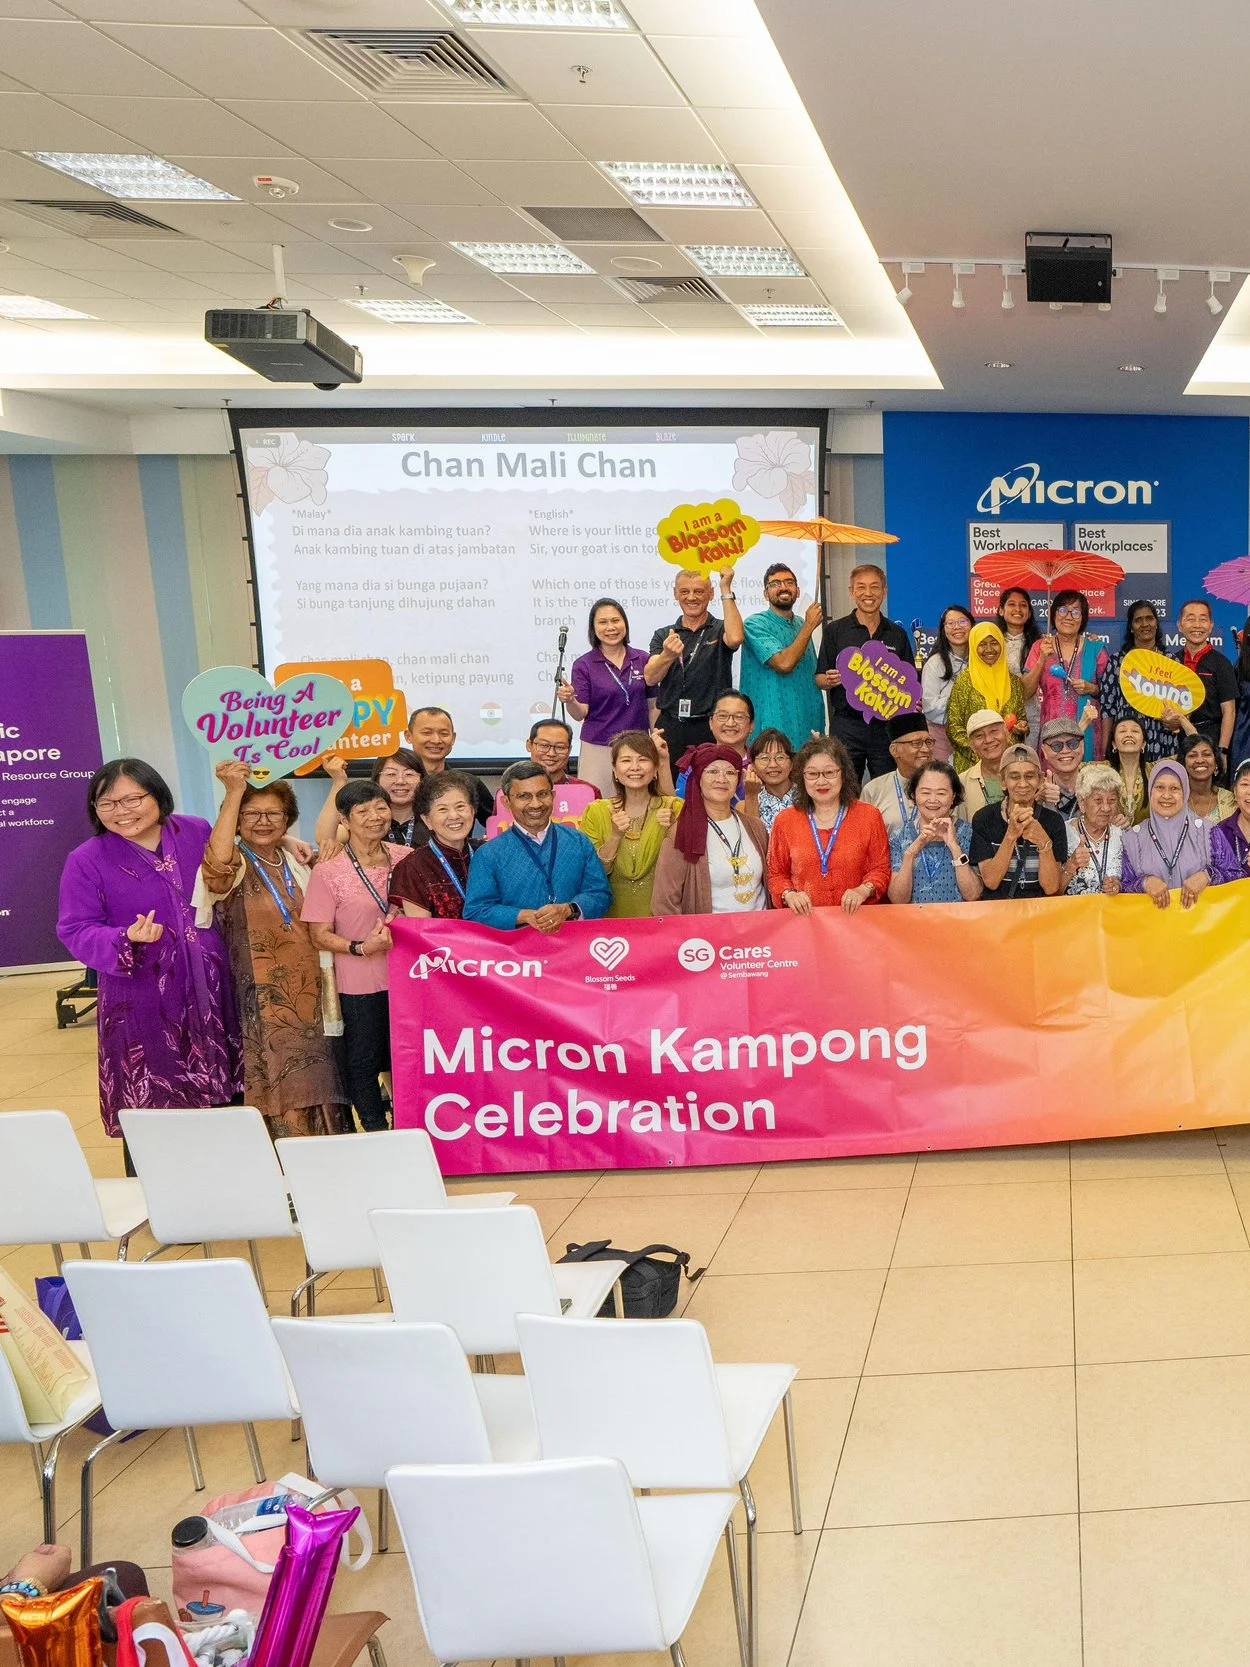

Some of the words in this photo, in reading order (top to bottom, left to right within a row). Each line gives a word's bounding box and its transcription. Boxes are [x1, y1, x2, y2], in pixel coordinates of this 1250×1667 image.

[401, 452, 484, 478] Chan
[497, 450, 566, 478] Mali
[577, 450, 657, 478] Chan
[976, 462, 1154, 514] Micron
[684, 521, 689, 531] I
[692, 516, 711, 529] am
[714, 512, 722, 521] a
[292, 526, 302, 536] Di
[307, 528, 339, 536] mana
[344, 526, 362, 536] dia
[366, 526, 395, 536] anak
[399, 526, 452, 539] kambing
[456, 525, 491, 536] tuan?
[529, 525, 568, 536] Where
[572, 525, 581, 536] is
[584, 527, 611, 538] your
[615, 525, 641, 536] little
[667, 519, 747, 553] Blossom
[973, 527, 1001, 538] Best
[1078, 528, 1106, 538] Best
[698, 536, 744, 563] Kaki!
[296, 581, 321, 593] Yang
[325, 582, 358, 590] mana
[363, 580, 381, 590] dia
[385, 580, 393, 590] si
[398, 580, 435, 593] bunga
[440, 580, 488, 593] pujaan?
[534, 615, 575, 626] branch
[875, 657, 883, 667] I
[881, 663, 898, 678] am
[898, 675, 906, 684] a
[1149, 665, 1154, 676] I
[1154, 667, 1173, 680] feel
[848, 652, 912, 709] Blossom
[220, 690, 287, 716] Being
[292, 681, 314, 704] A
[1126, 670, 1193, 710] Young
[855, 681, 899, 719] Kaki!
[196, 708, 342, 743] Volunteer
[233, 745, 261, 764] Is
[266, 737, 320, 760] Cool
[2, 771, 57, 781] Resource
[59, 770, 95, 779] Group
[1, 797, 37, 805] engage
[8, 818, 54, 827] workforce
[683, 949, 710, 962] SG
[719, 945, 772, 960] Cares
[409, 947, 544, 981] Micron
[720, 961, 765, 971] Volunteer
[767, 959, 798, 968] Centre
[615, 974, 635, 982] Seeds
[728, 971, 768, 979] Sembawang
[423, 1026, 627, 1075] Micron
[651, 1023, 928, 1078] Kampong
[424, 1089, 776, 1142] Celebration
